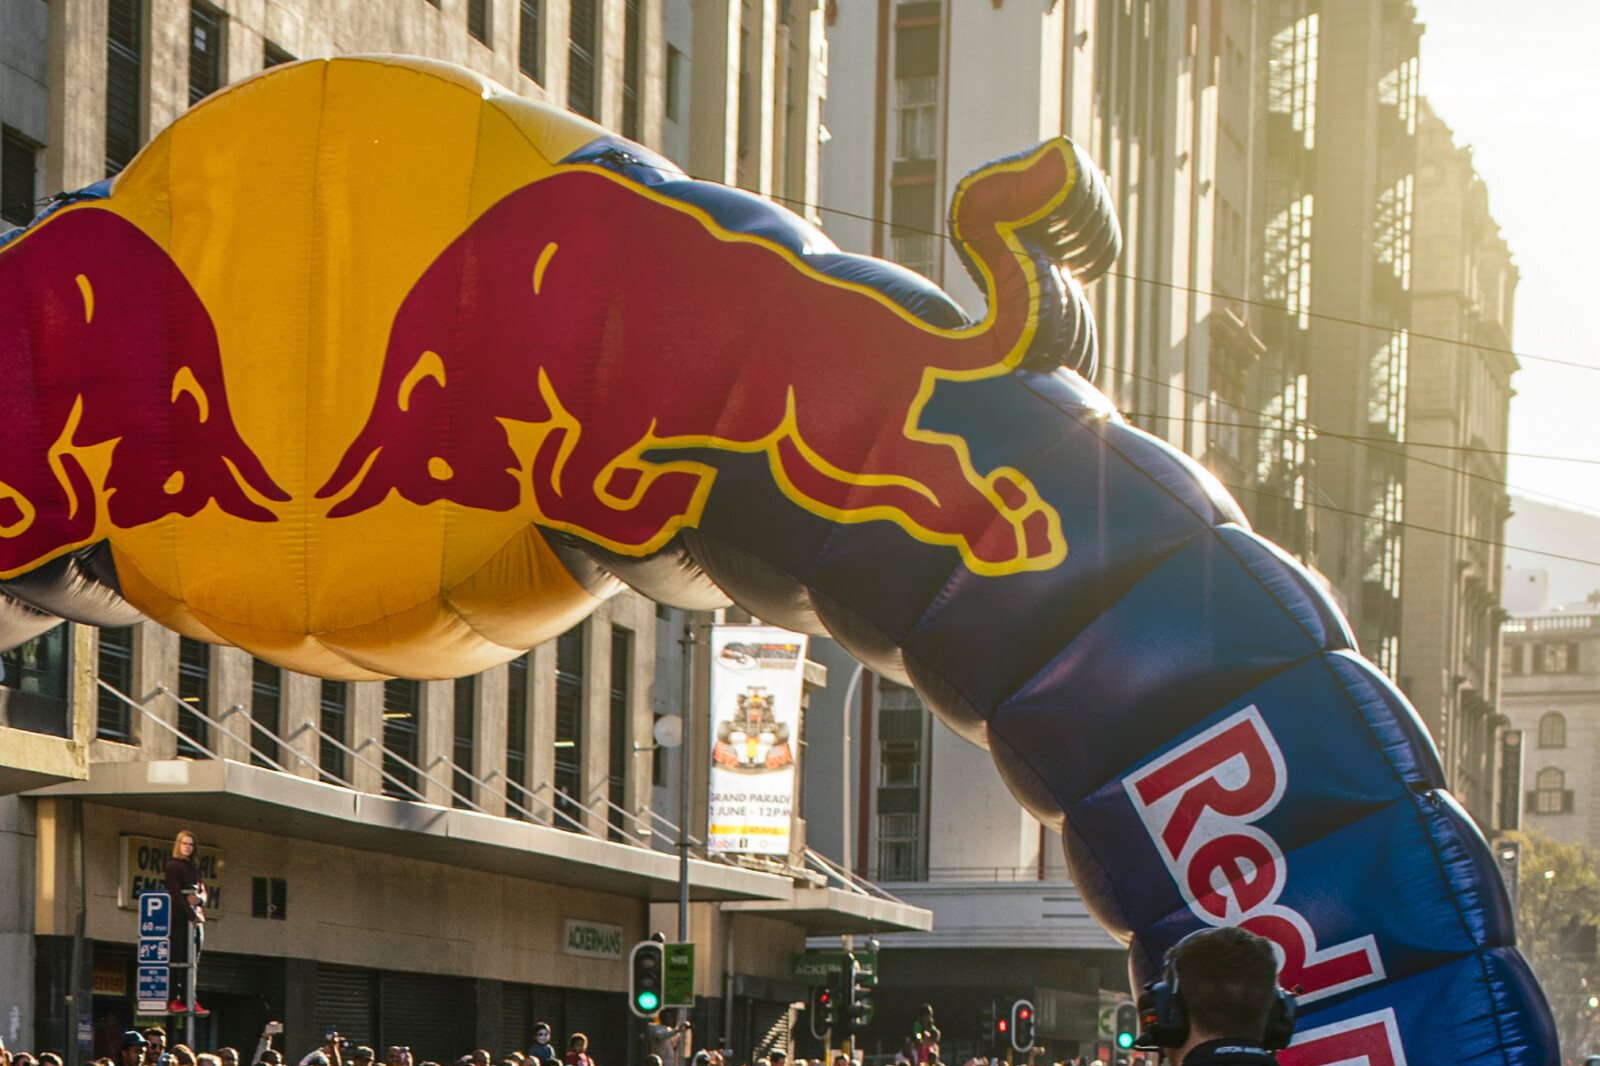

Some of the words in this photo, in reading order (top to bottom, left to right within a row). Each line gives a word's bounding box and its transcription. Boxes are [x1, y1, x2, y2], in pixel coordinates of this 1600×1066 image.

[1125, 707, 1384, 1002] Red
[147, 897, 159, 917] P
[567, 926, 623, 955] ACKERMANS
